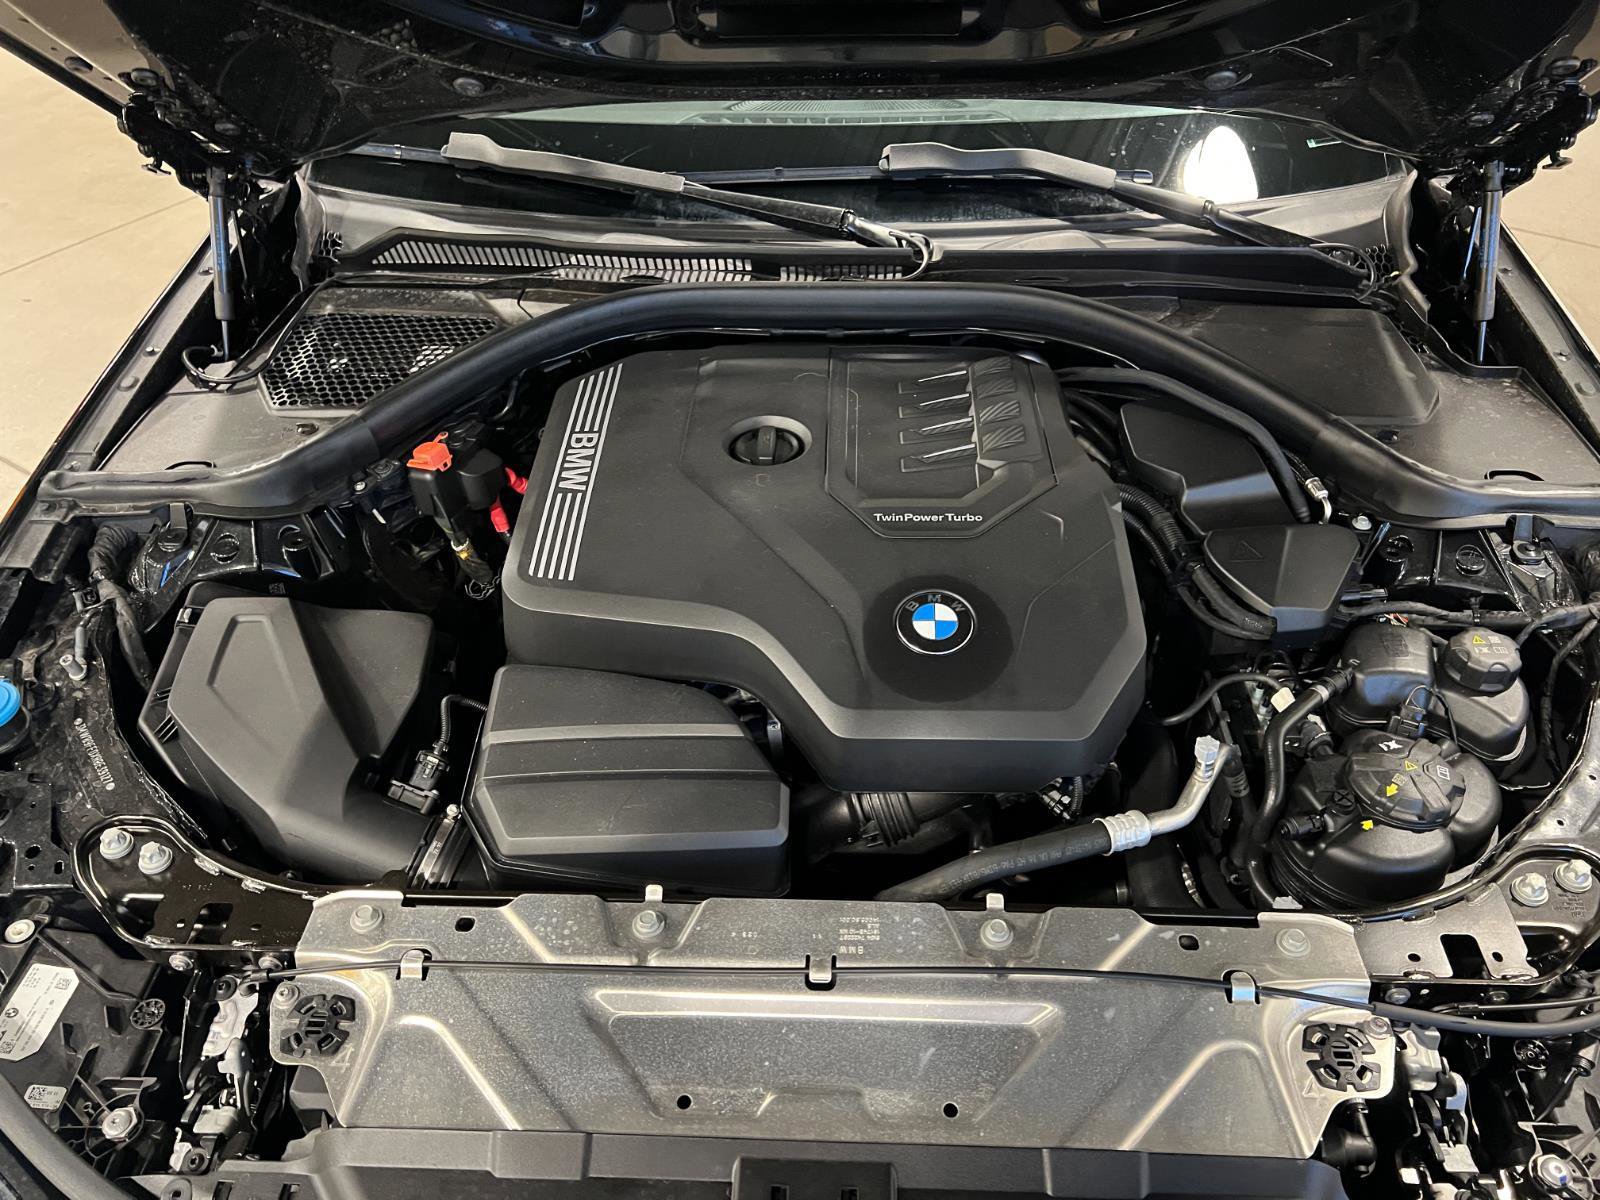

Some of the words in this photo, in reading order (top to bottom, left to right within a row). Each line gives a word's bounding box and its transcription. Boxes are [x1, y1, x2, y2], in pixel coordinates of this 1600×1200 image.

[559, 433, 599, 490] BMW
[873, 513, 944, 522] TwinPower
[945, 513, 983, 522] Turbo
[905, 594, 965, 612] BMW
